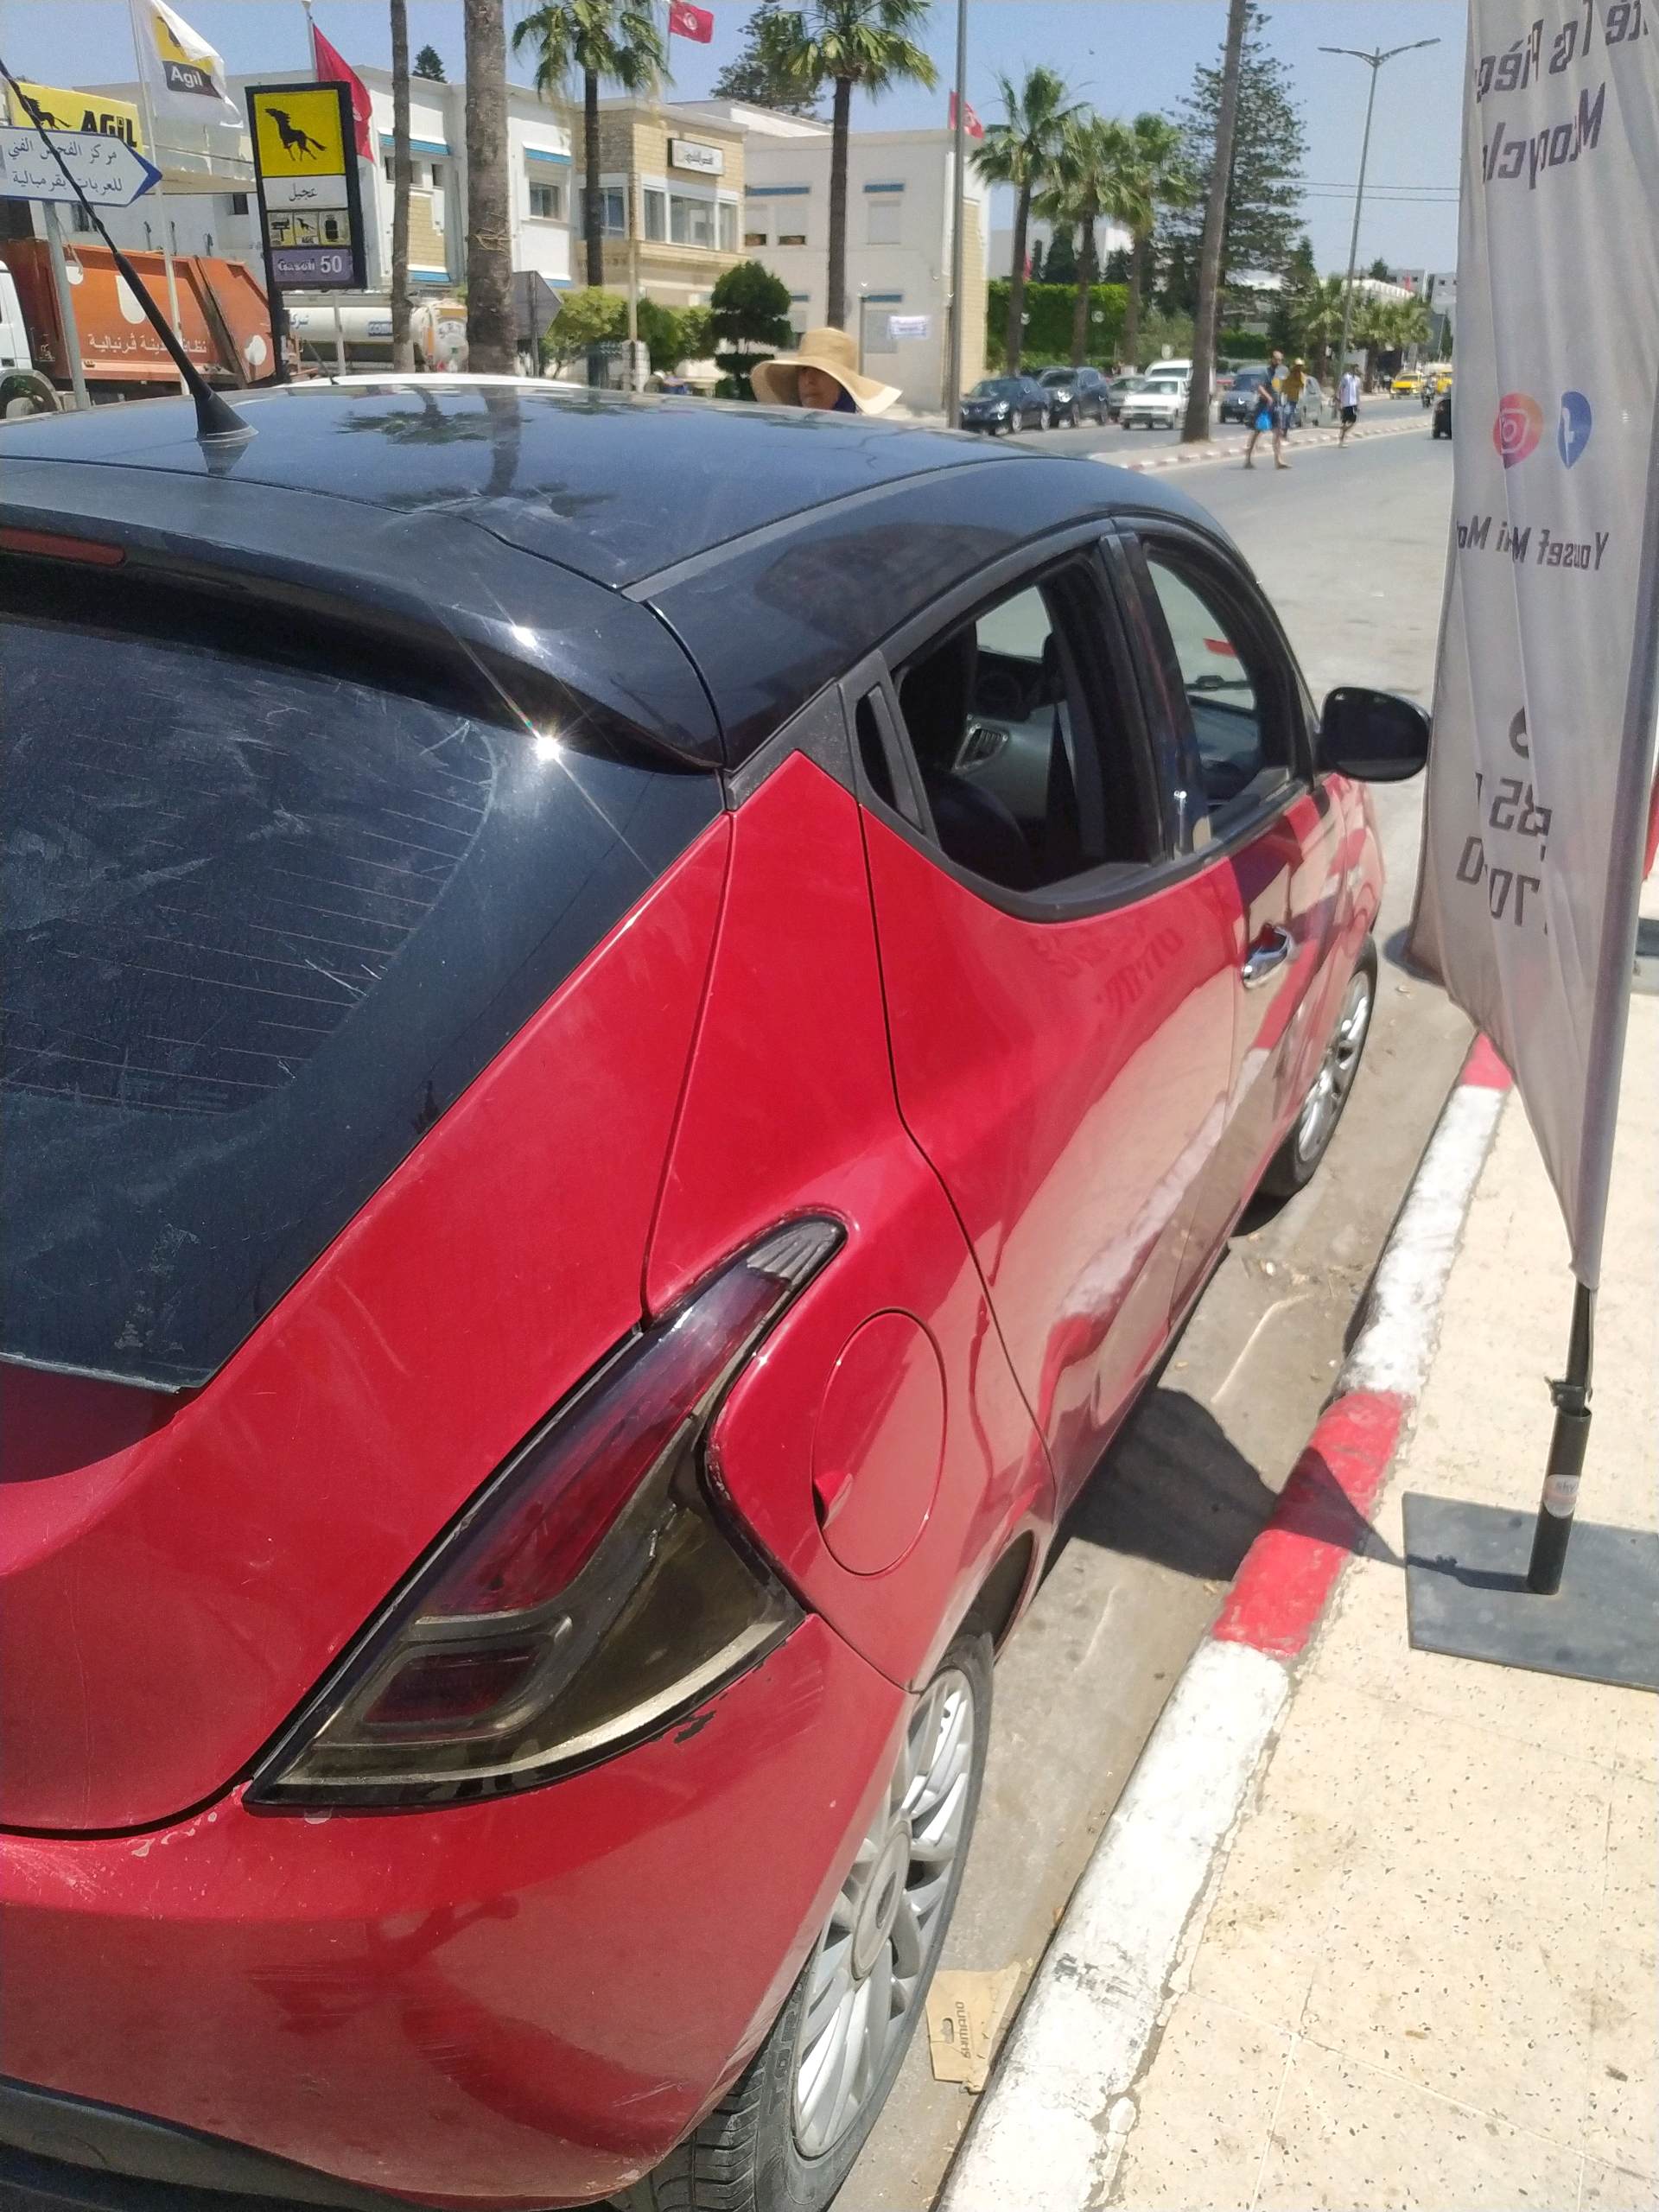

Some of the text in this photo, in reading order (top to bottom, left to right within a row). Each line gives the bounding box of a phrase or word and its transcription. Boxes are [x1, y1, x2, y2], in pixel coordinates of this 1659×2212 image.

[170, 66, 203, 88] Agil
[8, 137, 34, 161] الفني
[90, 143, 117, 164] مركز
[321, 255, 343, 273] 50
